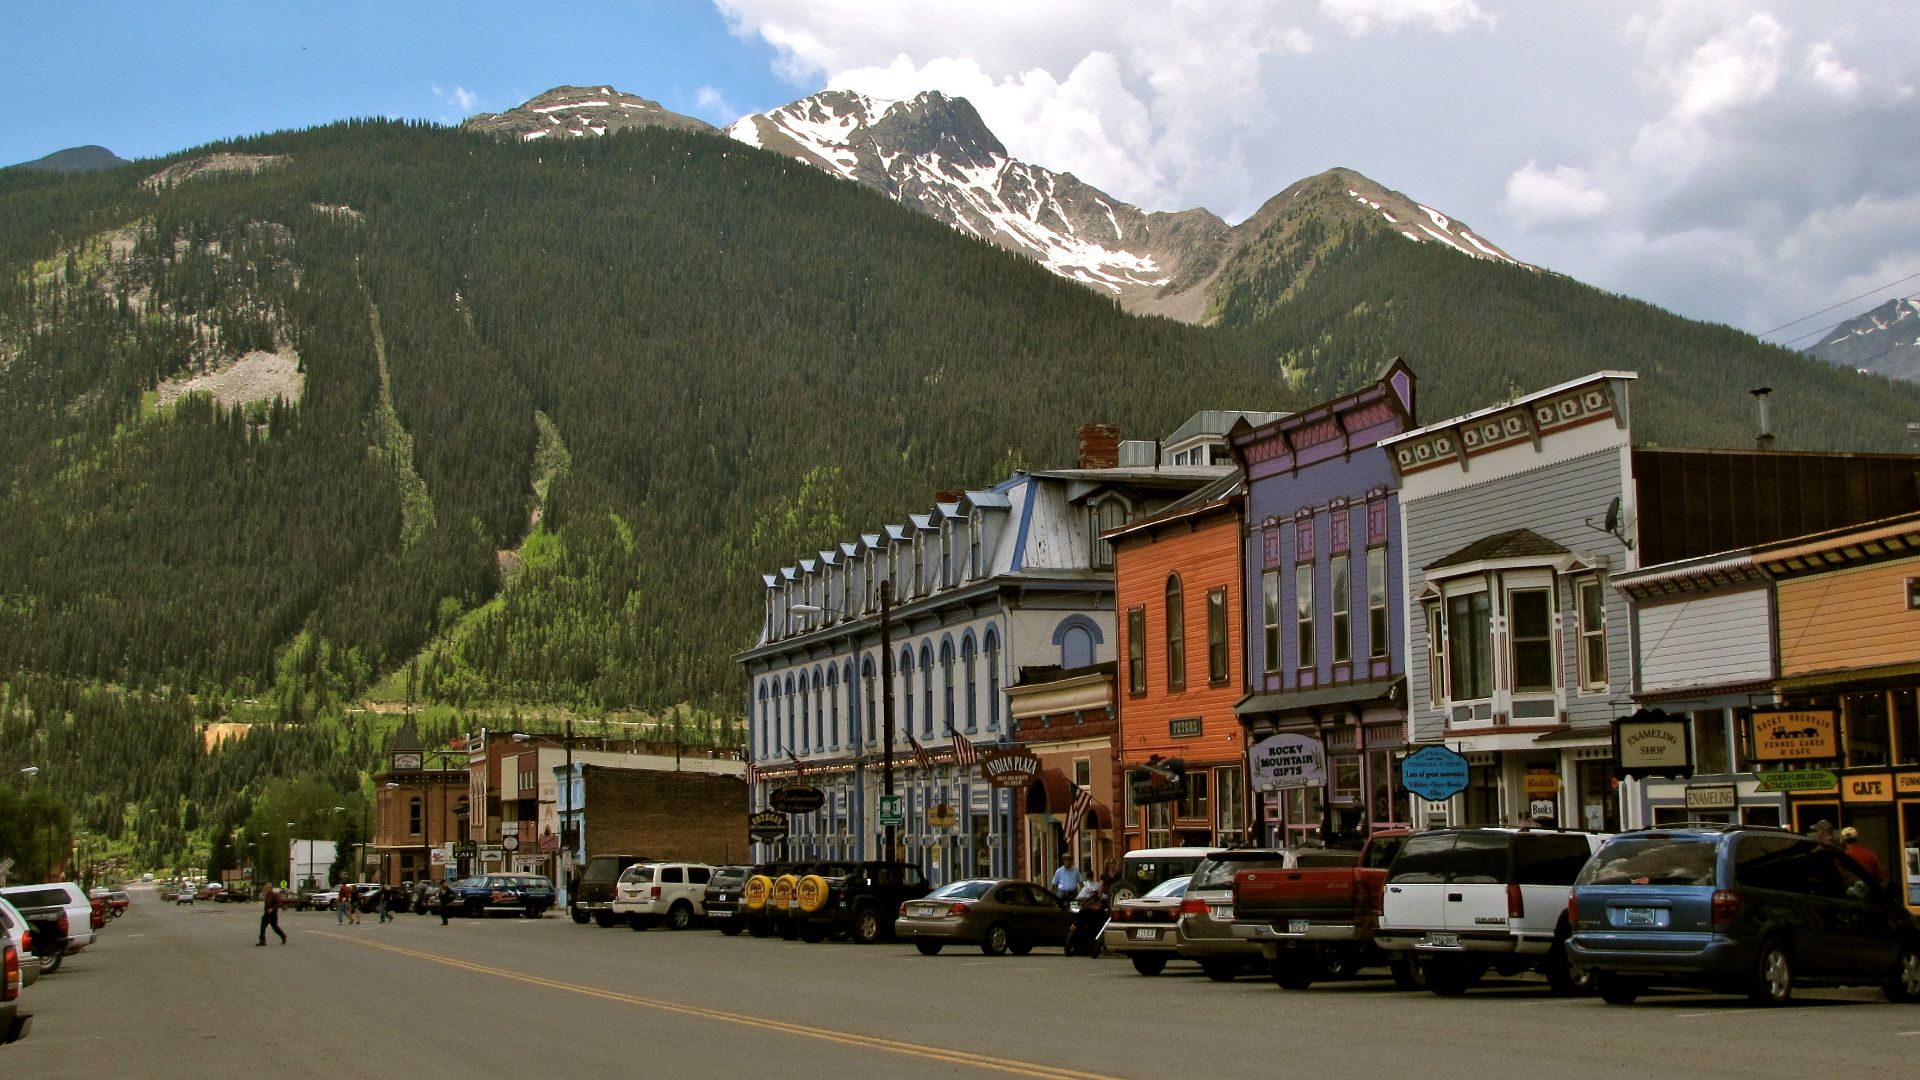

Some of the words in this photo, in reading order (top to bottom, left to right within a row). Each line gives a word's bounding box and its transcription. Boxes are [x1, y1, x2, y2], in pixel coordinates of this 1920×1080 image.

[1757, 716, 1781, 731] ROCKY
[1789, 714, 1830, 728] MOUNTAIN
[1627, 729, 1678, 746] ENAMELING
[1764, 740, 1794, 748] FUNNEL
[1799, 739, 1825, 747] CAKES
[1268, 744, 1303, 756] ROCKY
[1640, 745, 1666, 755] SHOP
[986, 756, 1013, 776] INDIAN
[1014, 756, 1037, 775] PLAZA
[1260, 755, 1313, 768] MOUNTAIN
[1273, 766, 1302, 777] GIFTS
[1528, 778, 1555, 788] Kodak
[1852, 781, 1882, 795] CAFE
[1687, 791, 1733, 805] ENAMELING
[1532, 804, 1553, 815] Books
